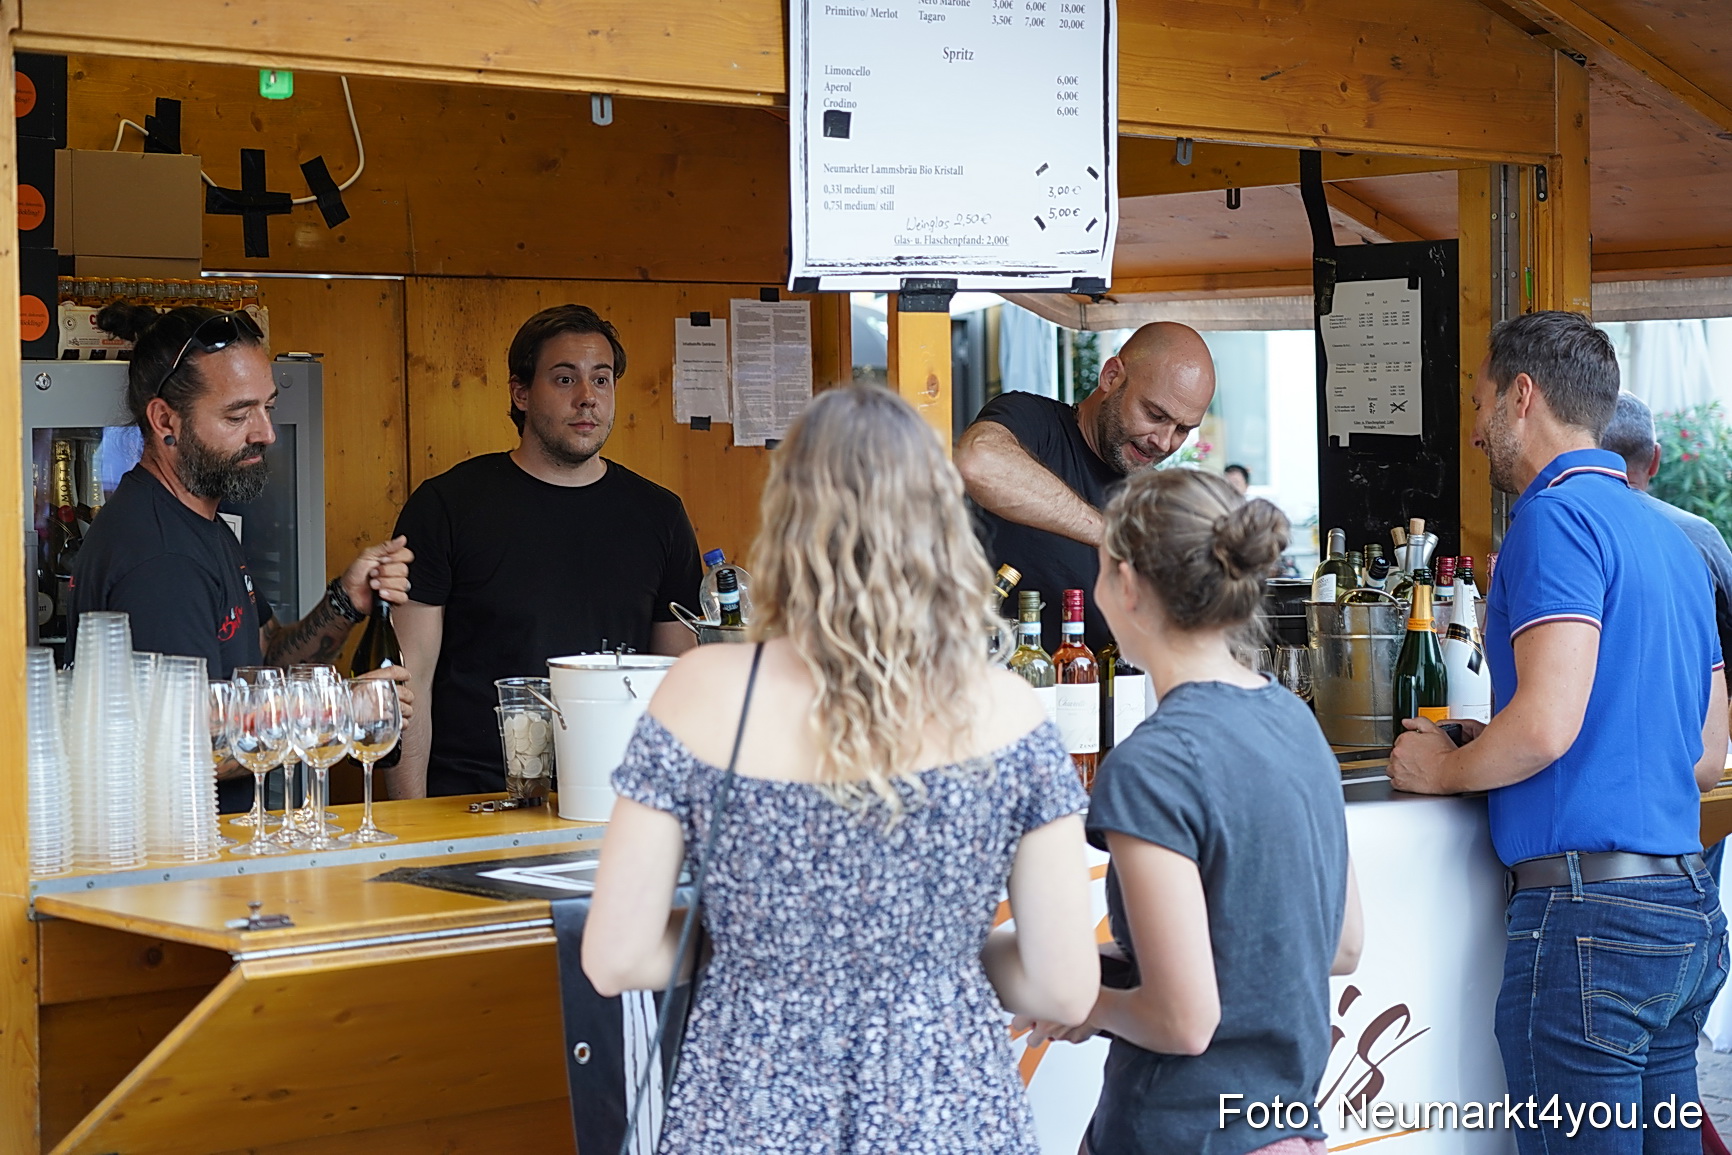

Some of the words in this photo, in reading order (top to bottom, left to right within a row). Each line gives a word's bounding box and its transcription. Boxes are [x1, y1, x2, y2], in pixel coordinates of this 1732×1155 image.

[992, 0, 1013, 10] 3,00€
[1026, 2, 1047, 12] 6,00€
[1060, 3, 1085, 14] 18,00€
[825, 5, 868, 17] Primitivo/
[870, 8, 898, 19] Merlot
[918, 10, 946, 23] Tagaro
[992, 15, 1013, 26] 3,50€
[1025, 17, 1045, 27] 7,00€
[1059, 19, 1085, 29] 20,00€
[942, 47, 974, 63] Spritz
[824, 65, 870, 76] Limoncello
[1057, 76, 1079, 86] 6,00€
[824, 82, 852, 94] Aperol
[1057, 91, 1079, 101] 6,00€
[823, 98, 857, 109] Crodino
[1057, 107, 1079, 117] 6,00€
[823, 163, 869, 174] Neumarkter
[871, 164, 917, 175] Lammsbräu
[919, 165, 932, 175] Bio
[934, 165, 964, 176] Kristall
[824, 184, 842, 195] 0,33l
[844, 185, 878, 195] medium/
[880, 185, 895, 195] still
[824, 201, 842, 211] 0,75l
[844, 201, 878, 211] medium/
[880, 201, 895, 211] still
[906, 216, 950, 232] Weinglas
[894, 235, 913, 245] Glas-
[924, 235, 984, 247] Flaschenpfand:
[987, 236, 1009, 246] 2,00€
